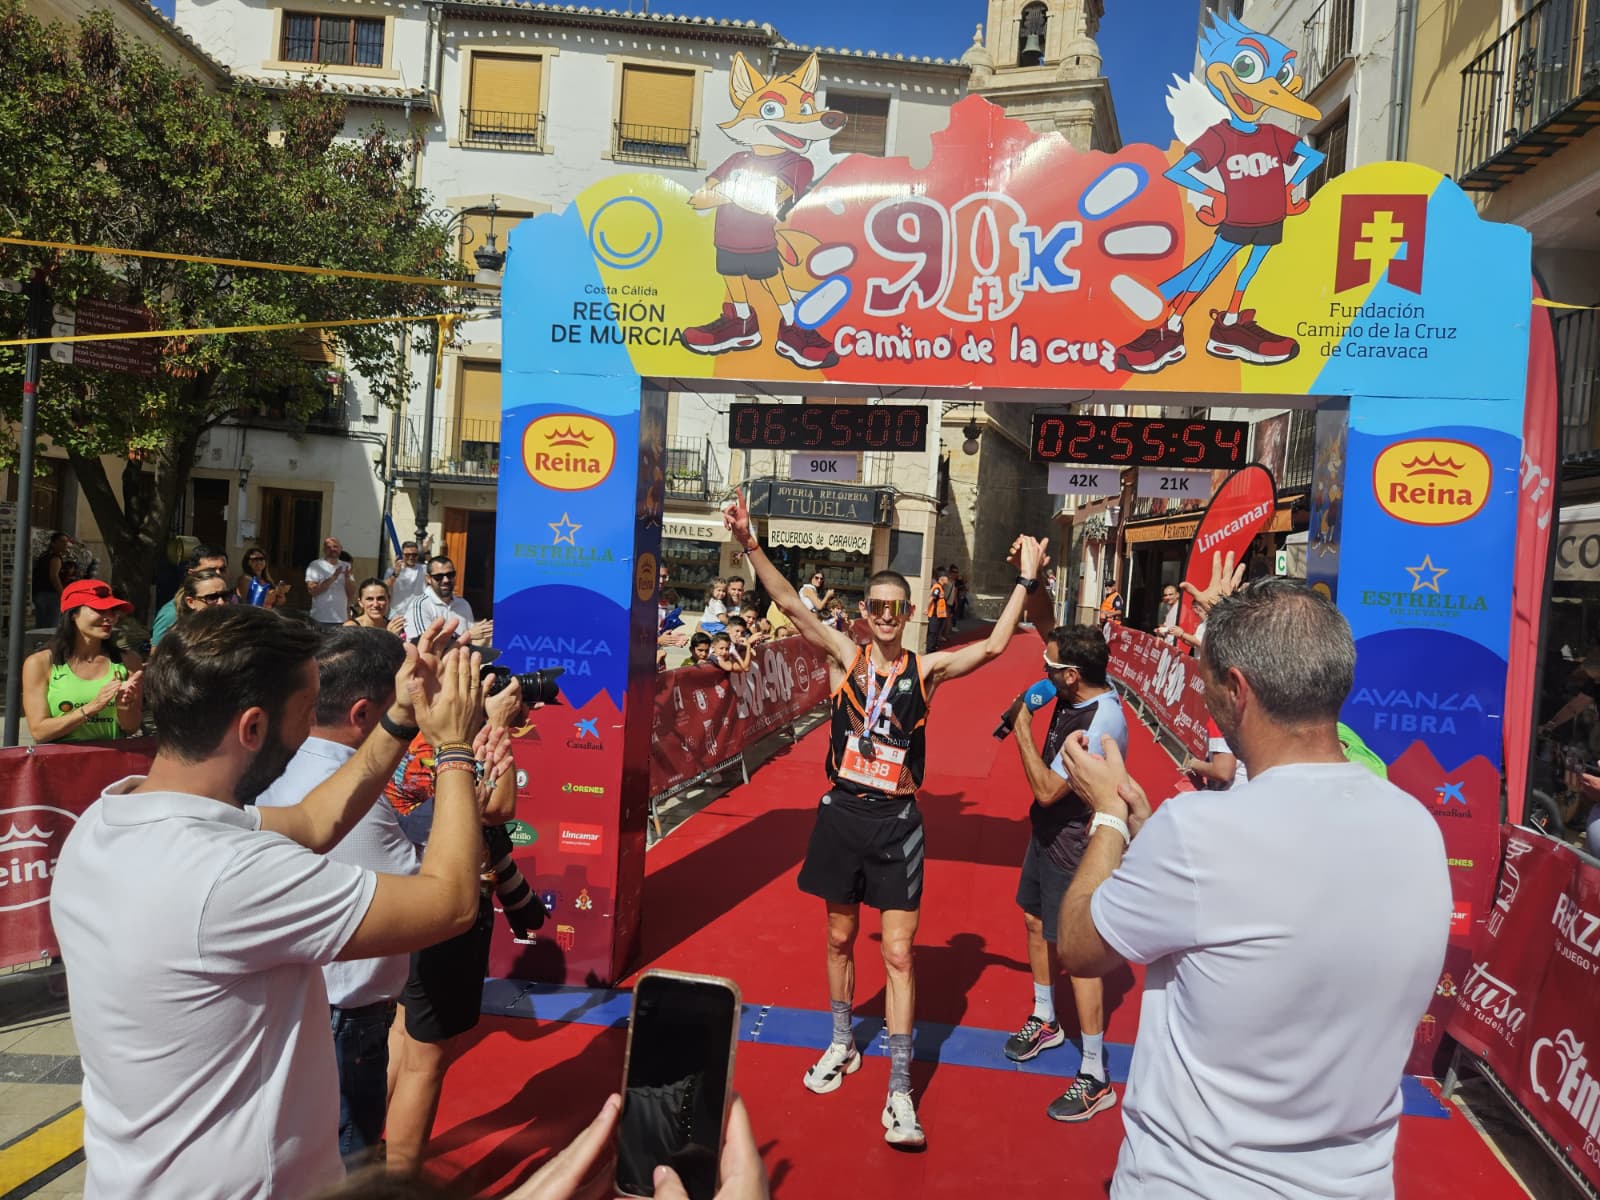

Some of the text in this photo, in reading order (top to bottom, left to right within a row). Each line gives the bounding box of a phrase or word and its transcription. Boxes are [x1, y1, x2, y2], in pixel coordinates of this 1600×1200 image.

[584, 283, 659, 297] Costa Cálida
[572, 299, 666, 323] REGIÓN
[1329, 302, 1425, 319] Fundación
[551, 324, 683, 347] DE MURCIA
[1296, 321, 1457, 340] Camino de la Cruz
[834, 326, 952, 362] Camino
[960, 333, 994, 365] de
[1010, 326, 1037, 364] la
[1320, 343, 1429, 359] de Caravaca
[735, 408, 920, 447] 06:55:00
[1038, 419, 1241, 462] 02:55:54
[533, 450, 601, 475] Reina
[810, 460, 838, 473] 90K
[1069, 474, 1099, 487] 42K
[1159, 478, 1189, 491] 21K
[1388, 481, 1473, 507] Reina
[786, 498, 858, 519] TUDELA
[1197, 502, 1270, 554] Limcamar
[771, 530, 867, 550] RECUERDOS de CARAVACA
[513, 543, 616, 562] ESTRELLA
[1360, 590, 1489, 612] ESTRELLA
[1351, 687, 1484, 712] AVANZA
[1373, 712, 1457, 735] FIBRA
[853, 756, 890, 777] 1138
[573, 784, 605, 795] ORENES
[562, 830, 600, 841] Limcamar
[1561, 946, 1600, 976] JUEGO Y
